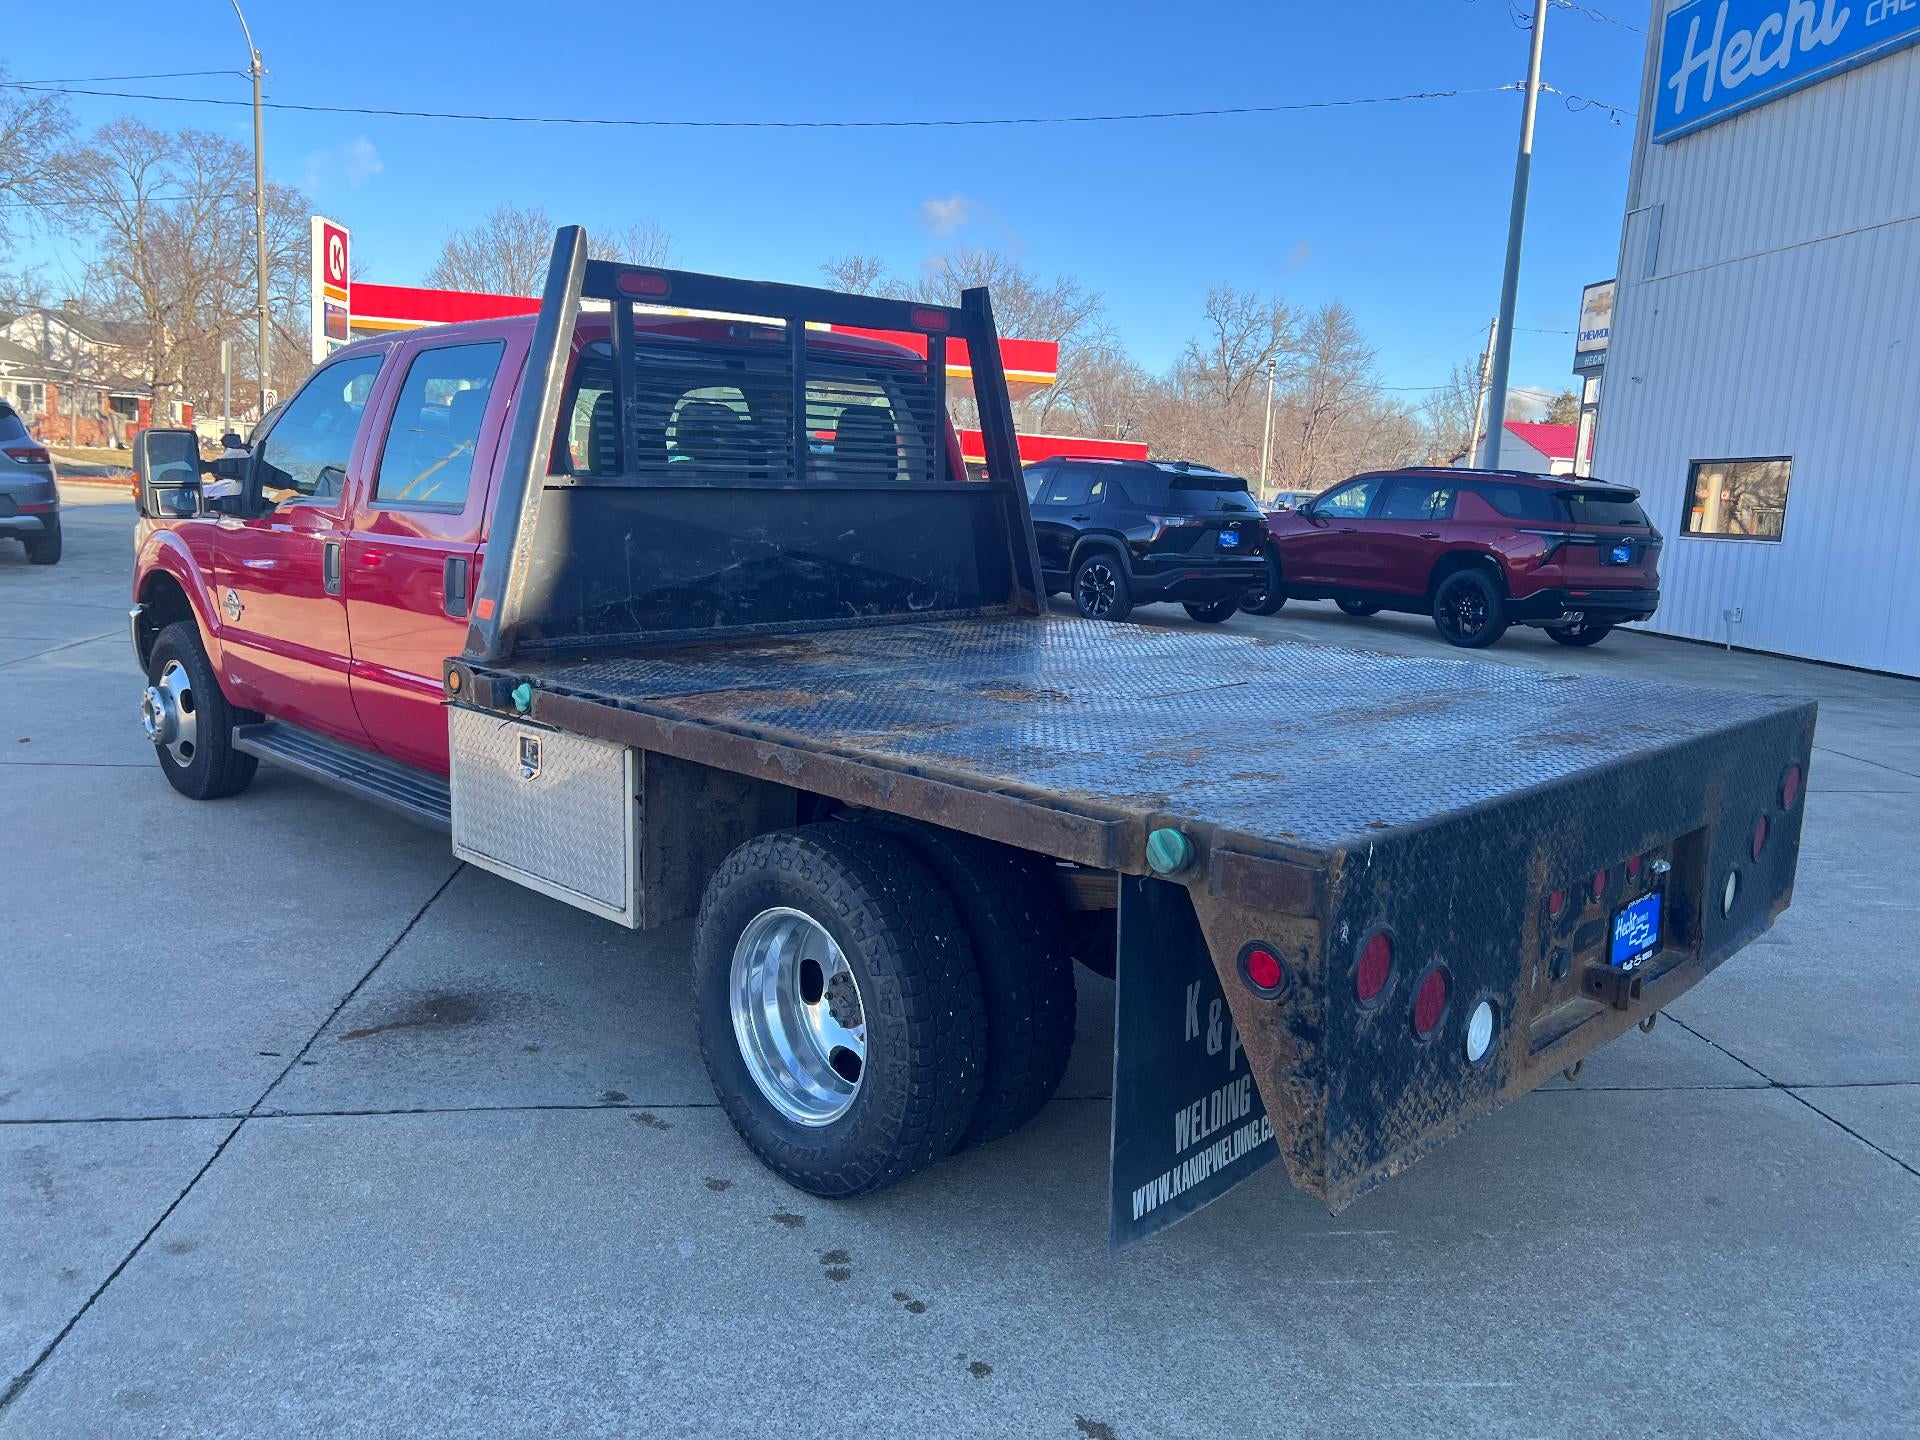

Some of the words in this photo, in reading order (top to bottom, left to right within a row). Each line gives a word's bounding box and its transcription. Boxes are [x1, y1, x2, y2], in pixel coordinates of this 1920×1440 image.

[1584, 353, 1606, 366] HECHT
[1185, 980, 1200, 1042] K
[1206, 998, 1222, 1056] &
[1175, 1074, 1250, 1154] WELDING
